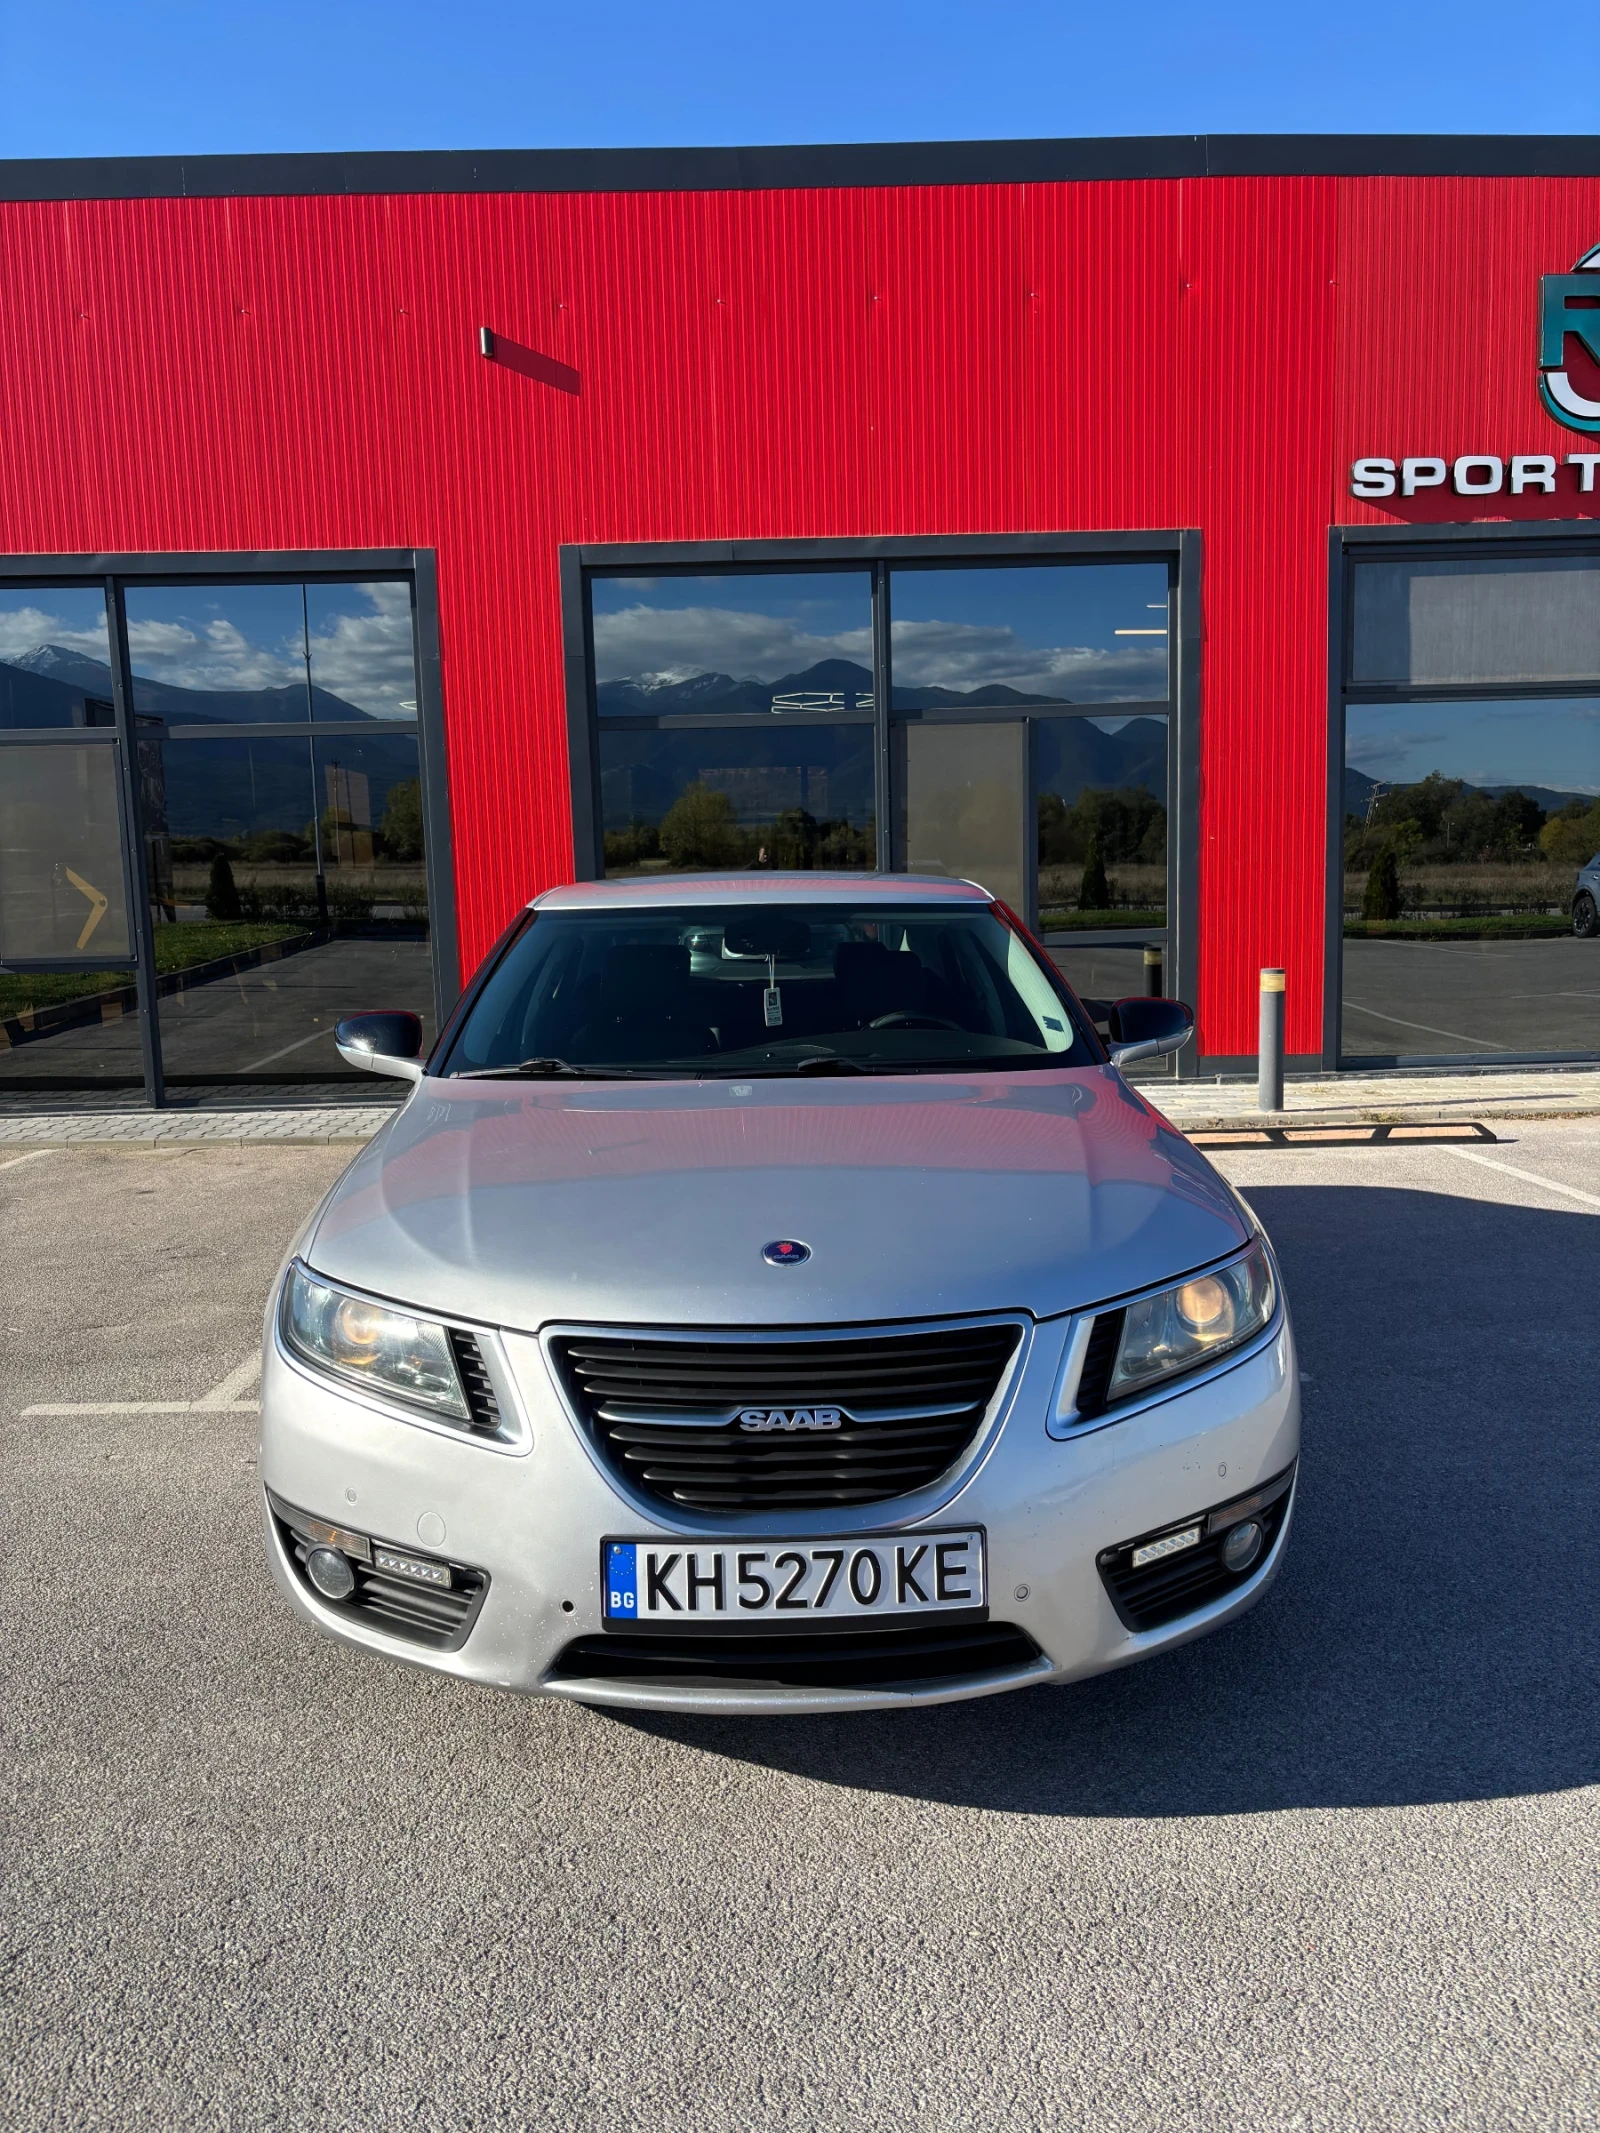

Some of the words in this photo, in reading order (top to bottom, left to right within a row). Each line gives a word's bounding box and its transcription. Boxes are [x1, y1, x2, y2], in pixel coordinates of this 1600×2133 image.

[1350, 453, 1600, 497] SPORT
[740, 1408, 842, 1432] SAAB
[609, 1591, 635, 1609] BG
[736, 1547, 882, 1610] 5270
